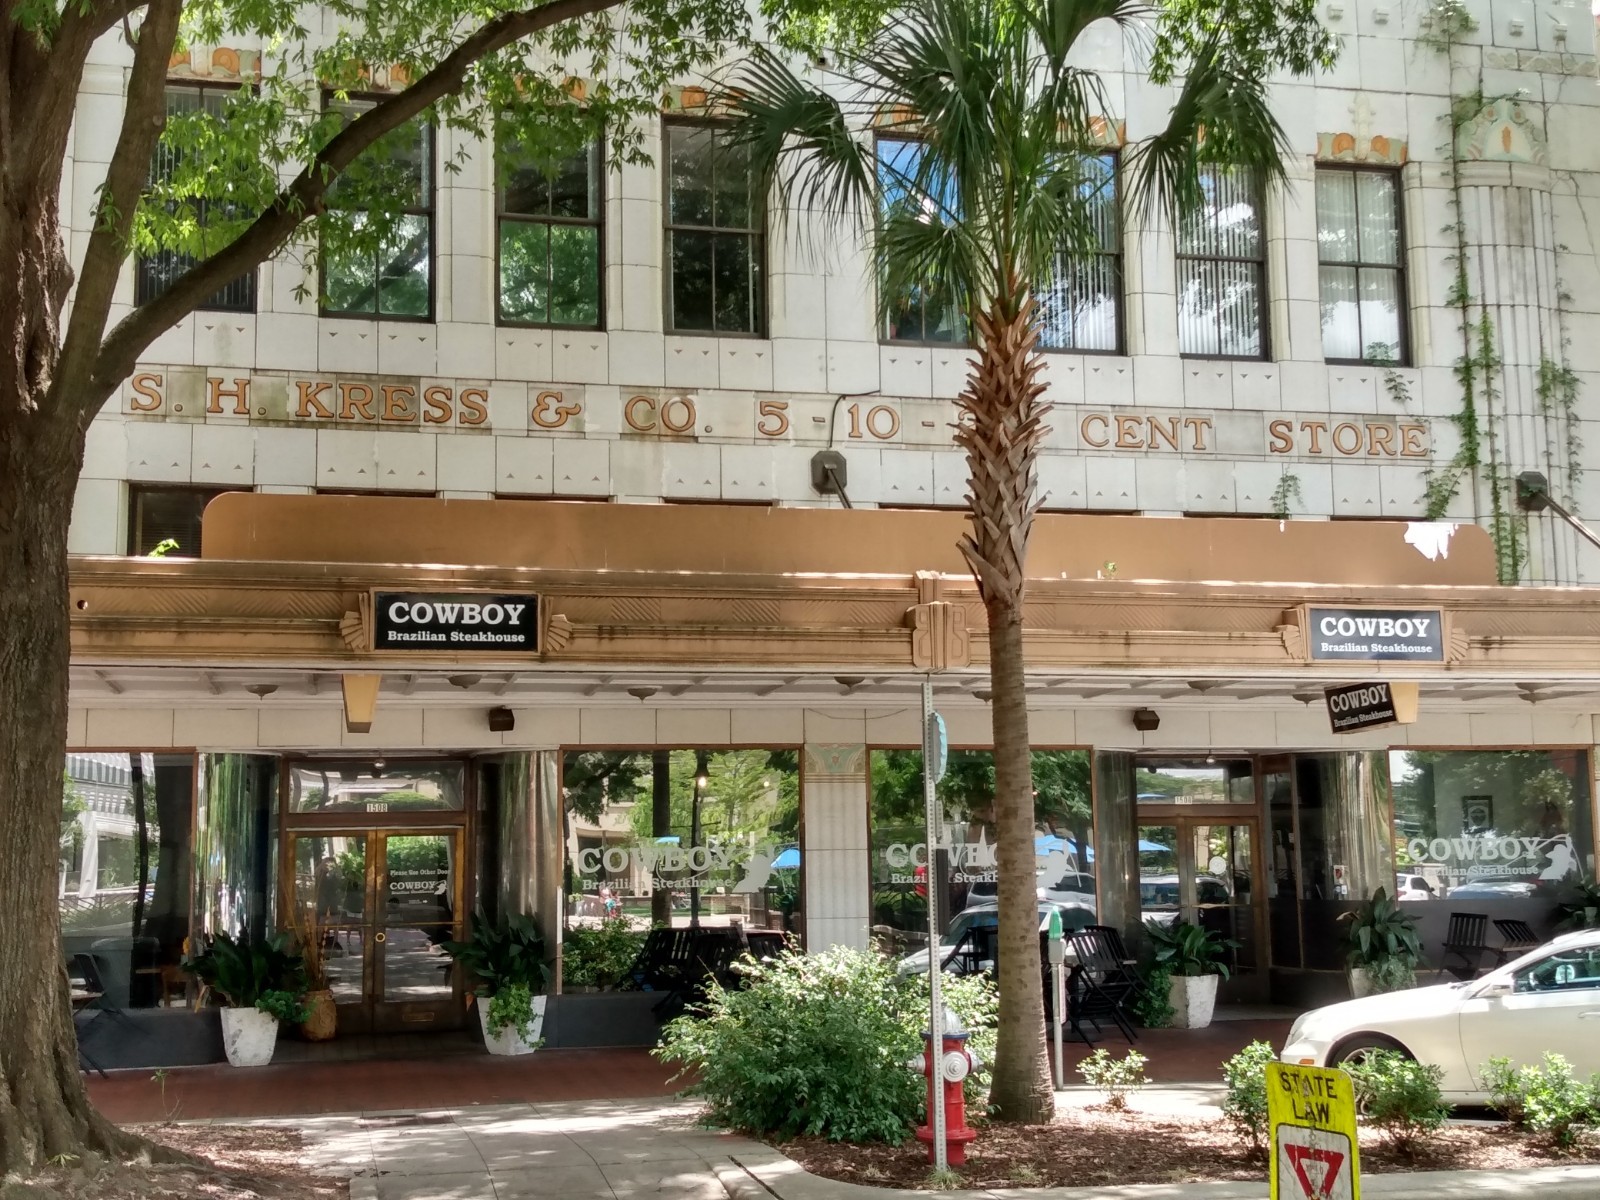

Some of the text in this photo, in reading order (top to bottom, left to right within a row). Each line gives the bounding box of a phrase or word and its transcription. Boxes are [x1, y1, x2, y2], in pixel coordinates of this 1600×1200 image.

[295, 381, 489, 425] KRESS
[531, 391, 582, 428] &
[624, 395, 713, 434] CO.
[1080, 413, 1213, 450] CENT
[1268, 419, 1428, 457] STORE
[388, 601, 526, 625] COWBOY
[387, 630, 526, 642] Brazilian Steakhouse
[1320, 617, 1431, 638] COWBOY
[1320, 642, 1433, 653] Brazilian Steakhouse
[1329, 683, 1389, 713] COWBOY
[1358, 709, 1394, 723] Steakhouse
[1407, 836, 1542, 862] COWBOY
[577, 846, 736, 874] COWBOY
[1414, 865, 1539, 876] Bilian Steakhouse
[390, 869, 408, 877] Please
[390, 881, 436, 890] COWBOY
[651, 876, 732, 892] Steakhouse
[1280, 1070, 1338, 1100] STATE
[1291, 1097, 1330, 1125] LAW
